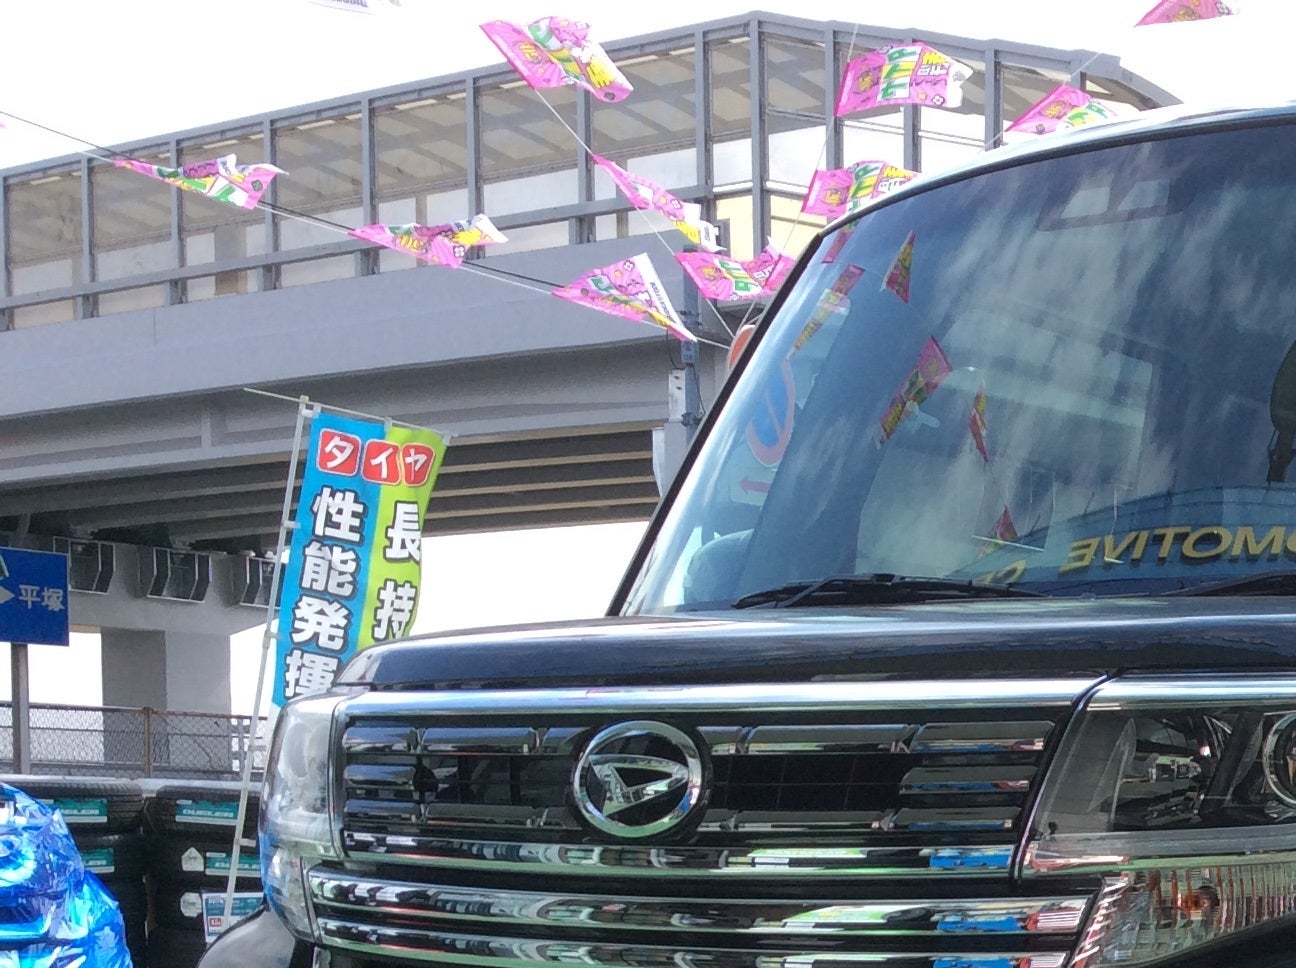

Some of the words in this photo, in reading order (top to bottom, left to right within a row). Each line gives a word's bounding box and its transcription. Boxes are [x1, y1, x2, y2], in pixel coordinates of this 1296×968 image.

[323, 435, 428, 481] タイヤ
[18, 584, 65, 611] 平塚
[284, 486, 364, 698] 性能発揮
[182, 808, 235, 817] DUELER
